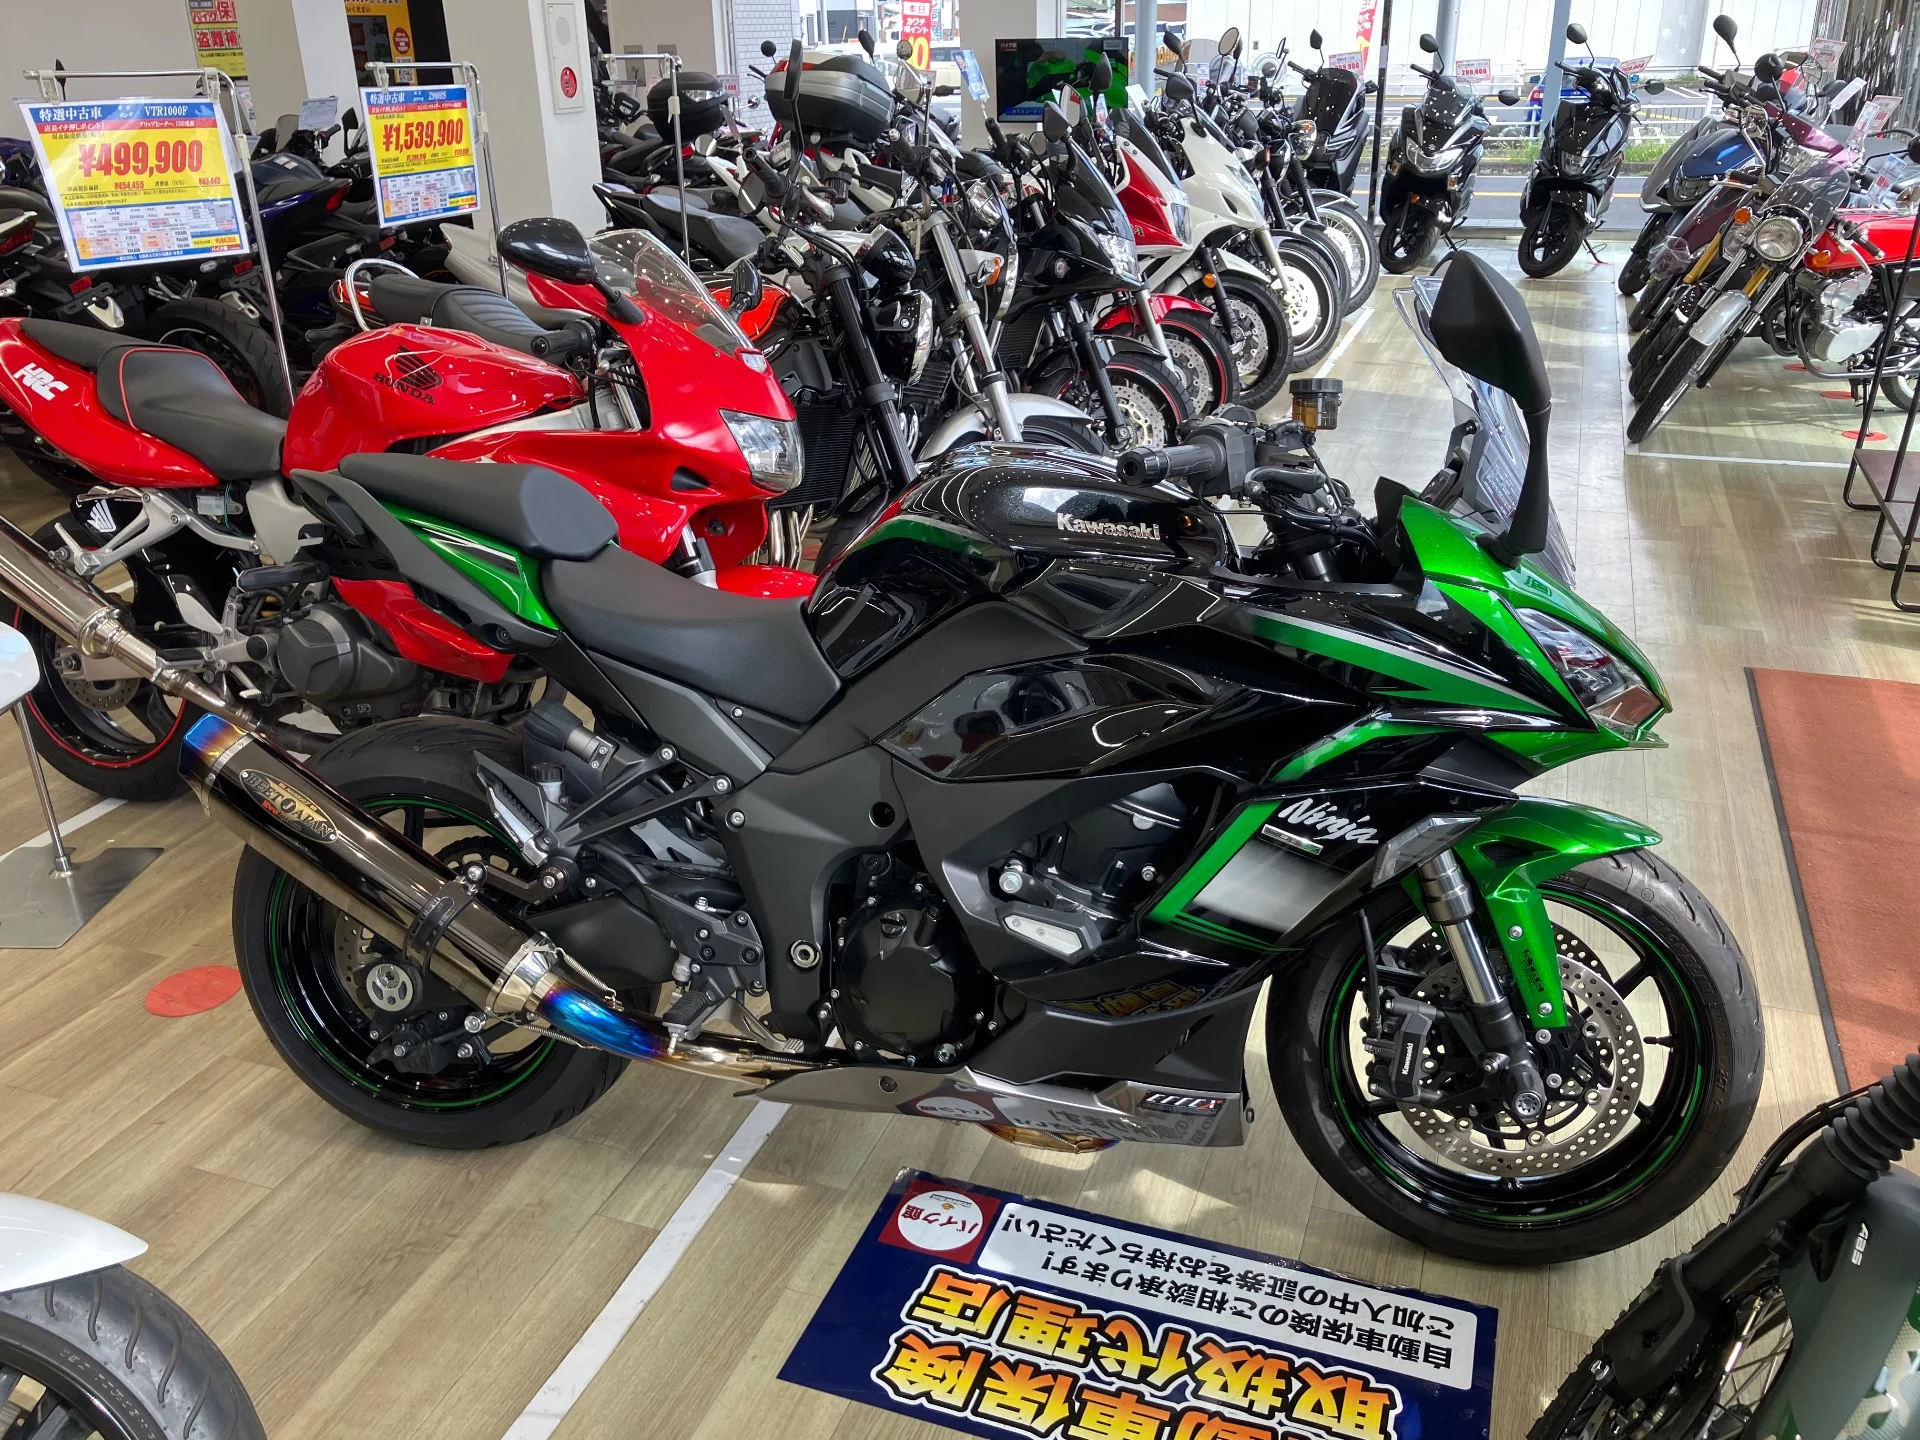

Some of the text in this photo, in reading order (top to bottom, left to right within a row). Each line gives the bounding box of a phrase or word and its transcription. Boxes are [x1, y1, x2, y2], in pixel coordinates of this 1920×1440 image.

[39, 106, 103, 121] 特選中古車
[144, 105, 188, 117] VTR1000F
[383, 118, 464, 153] ¥1,539,900
[78, 139, 204, 178] ¥499,900
[374, 371, 435, 405] HONDA
[1056, 512, 1161, 541] Kawasaki
[280, 797, 334, 838] JAPAN
[1277, 797, 1379, 844] Ninja
[1401, 1042, 1414, 1075] Kawasaki
[901, 1204, 980, 1234] バイク館
[1851, 1222, 1868, 1266] ABS
[1001, 1212, 1455, 1340] ご加入中の証券をお持ちください!
[1042, 1251, 1453, 1369] 自動車保険のご相談承ります!
[912, 1271, 1391, 1440] 取扱代理店
